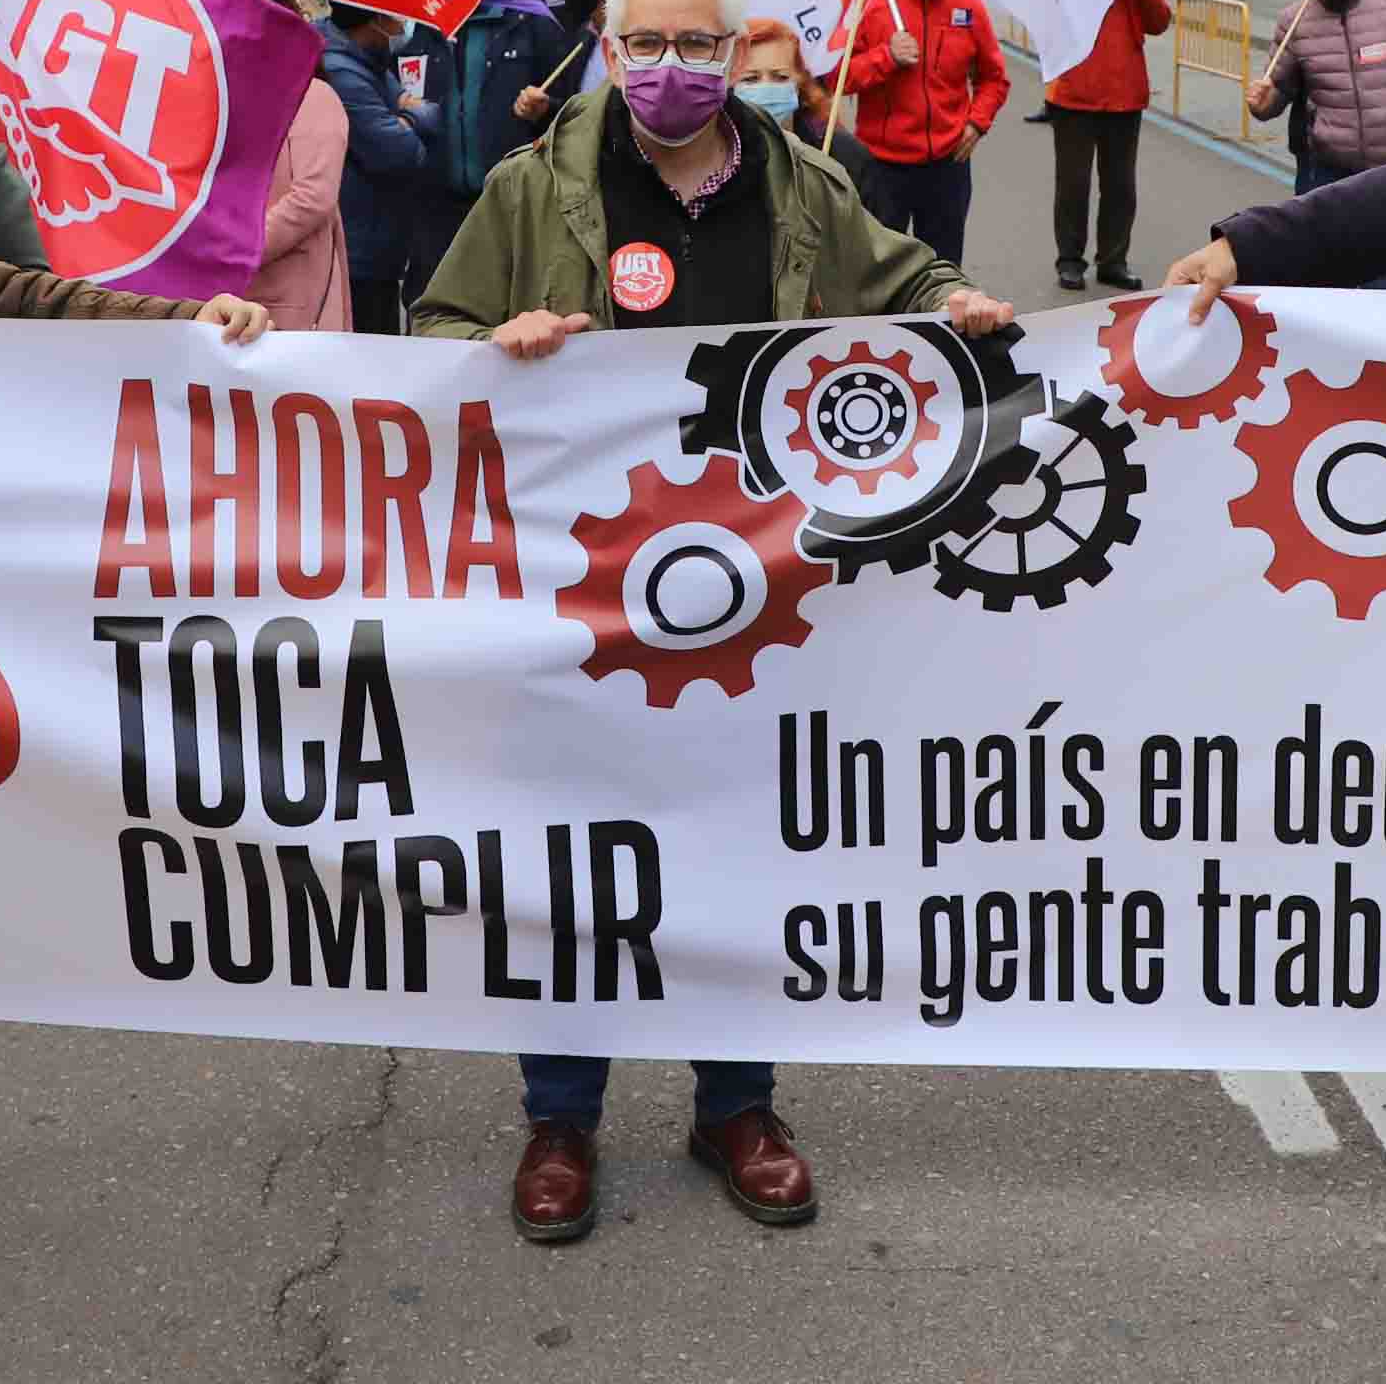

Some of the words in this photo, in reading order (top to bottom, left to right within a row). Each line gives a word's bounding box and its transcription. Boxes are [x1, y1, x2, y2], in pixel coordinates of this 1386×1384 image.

[615, 252, 661, 275] UGT
[94, 377, 524, 601] AHORA
[93, 614, 415, 828] TOCA
[779, 709, 886, 853] Un
[920, 700, 1106, 868] país
[1139, 733, 1239, 844] en
[117, 818, 665, 1004] CUMPLIR
[781, 898, 885, 1004] su
[919, 856, 1166, 1028] gente
